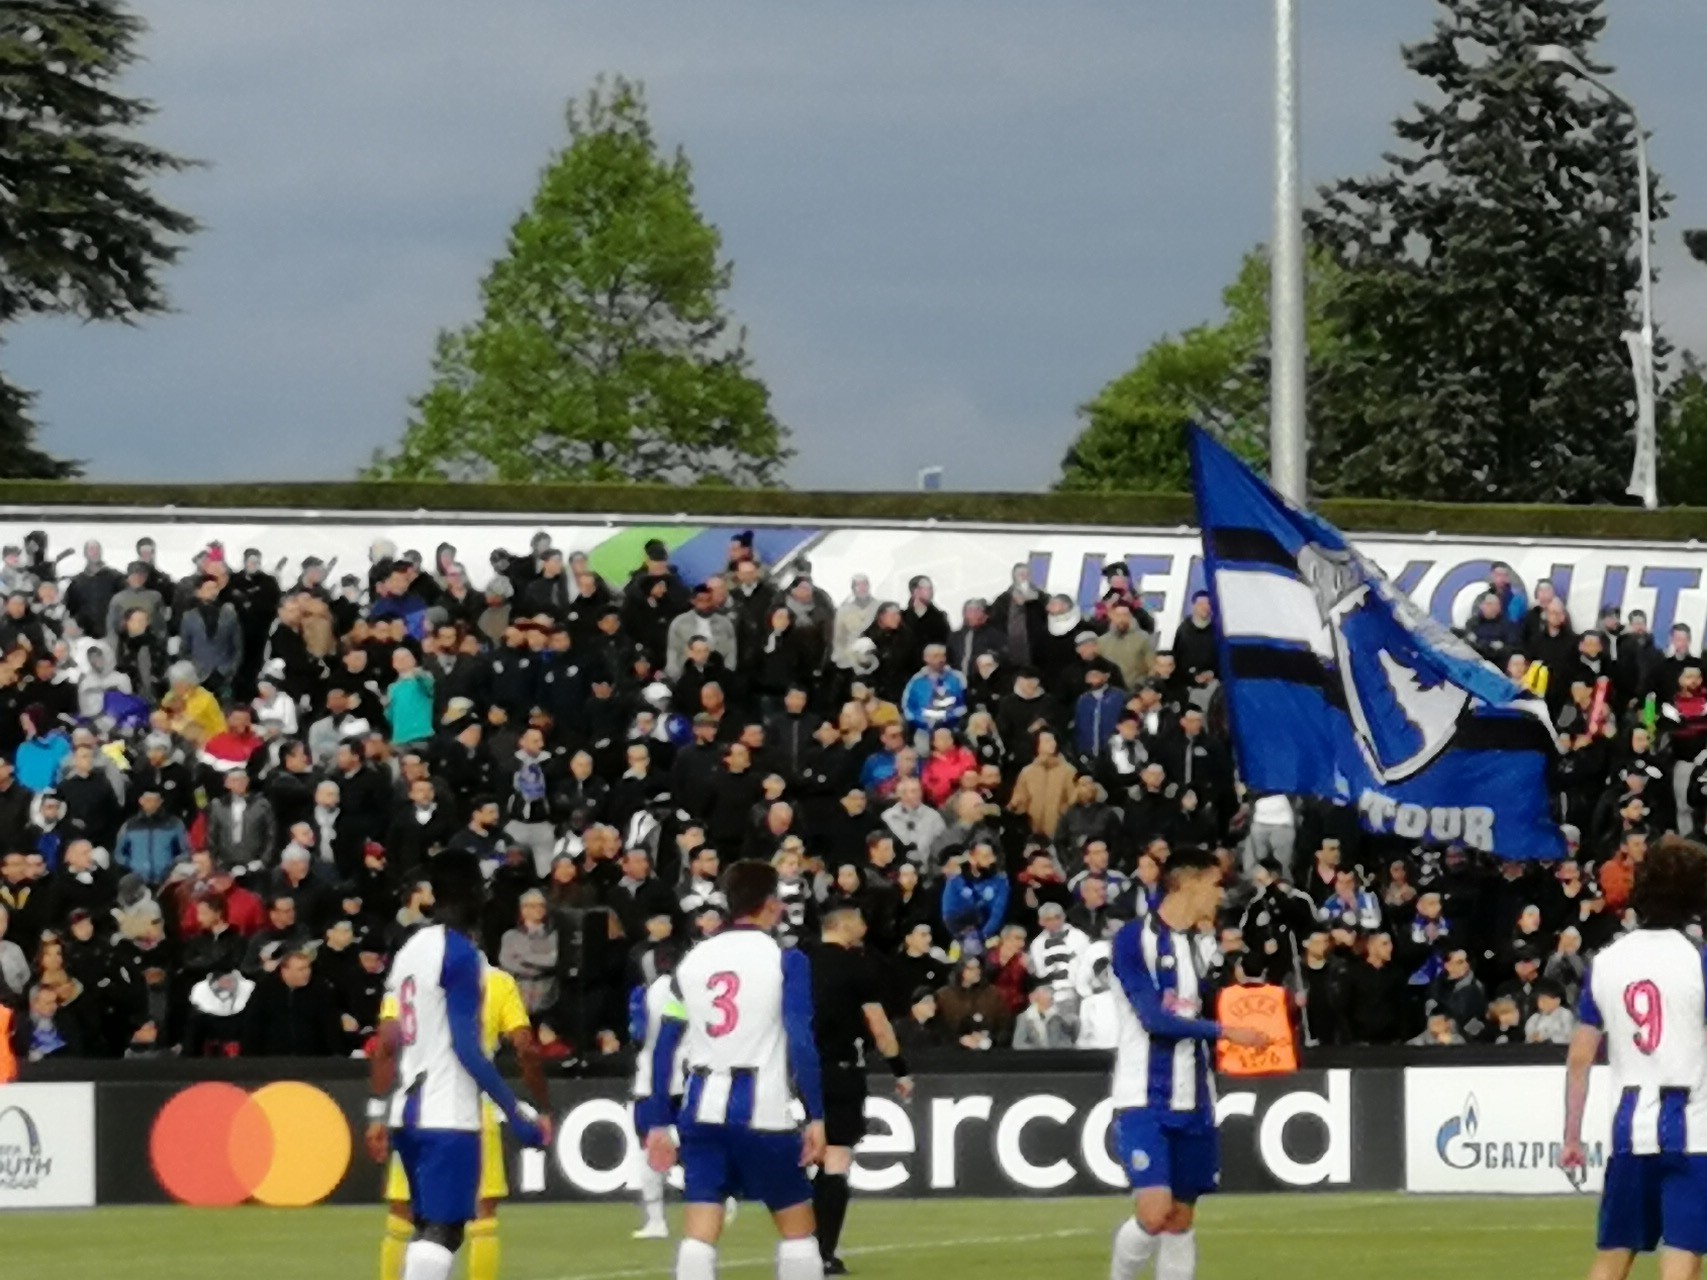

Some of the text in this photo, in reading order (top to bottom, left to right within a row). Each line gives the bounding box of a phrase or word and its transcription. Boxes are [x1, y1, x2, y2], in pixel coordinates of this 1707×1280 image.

[1357, 786, 1496, 852] TOUR
[706, 971, 741, 1038] 3
[1623, 979, 1663, 1055] 9
[1485, 1140, 1603, 1169] GAZPRM
